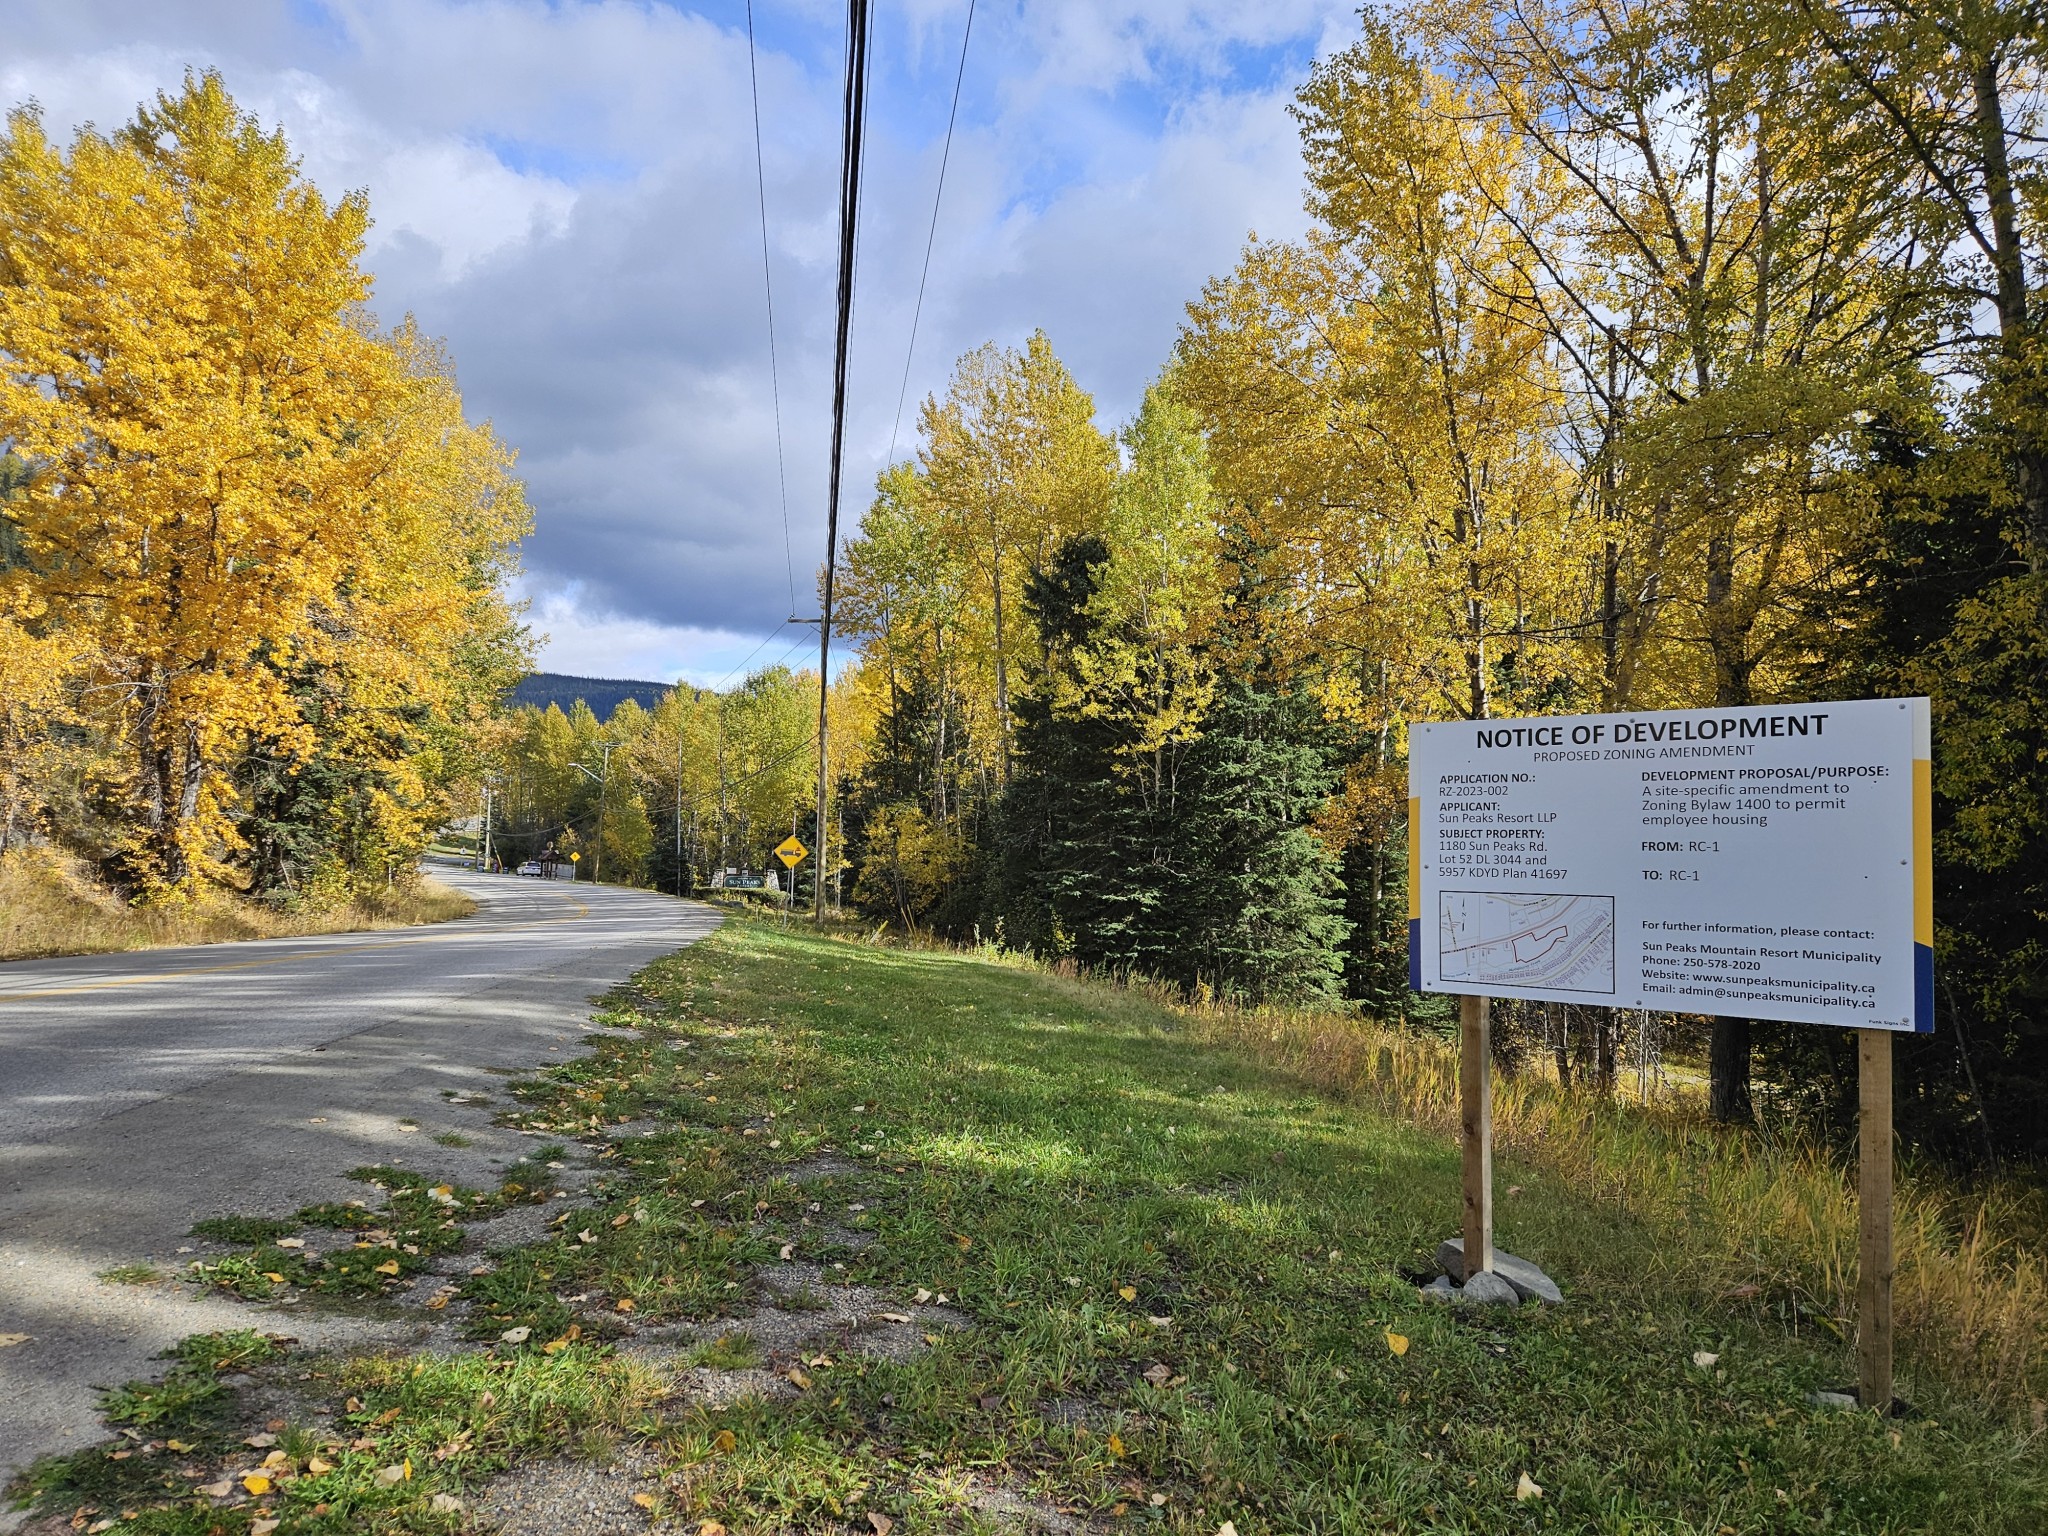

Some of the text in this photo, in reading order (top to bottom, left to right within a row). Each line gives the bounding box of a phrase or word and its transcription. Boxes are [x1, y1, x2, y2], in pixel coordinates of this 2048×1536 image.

[1477, 714, 1828, 749] NOTICE OF DEVELOPMENT
[1533, 744, 1756, 762] PROPOSED ZONING AMENDMENT
[1440, 773, 1536, 784] APPLICATION NO.:
[1642, 766, 1889, 782] DEVELOPMENT PROPOSAL/PURPOSE:
[1439, 786, 1509, 797] RZ-2023-002
[1642, 782, 1849, 797] A site-specific amendment to
[1440, 802, 1500, 811] APPLICANT:
[1642, 798, 1846, 812] Zoning Bylaw 1400 to permit
[1439, 813, 1557, 823] Sun Peaks Resort LLP
[1642, 814, 1768, 827] employee housing
[1439, 829, 1545, 839] SUBJECT PROPERTY:
[1440, 841, 1547, 852] 1180 Sun Peaks Rd.
[1642, 841, 1720, 852] FROM: RC-1
[1439, 855, 1547, 865] Lot 52 DL 3044 and
[1439, 868, 1568, 879] 5957 KDYD Plan 41697
[1642, 870, 1699, 881] TO: RC-1
[1642, 920, 1874, 940] For further information, please contact:
[1642, 941, 1881, 964] Sun Peaks Mountain Resort Municipality
[1642, 956, 1760, 971] Phone: 250-578-2020
[1642, 969, 1875, 994] Website: www.sunpeaksmunicipality.ca
[1643, 982, 1875, 1009] Email: admin@sunpeaksmunicipality.ca
